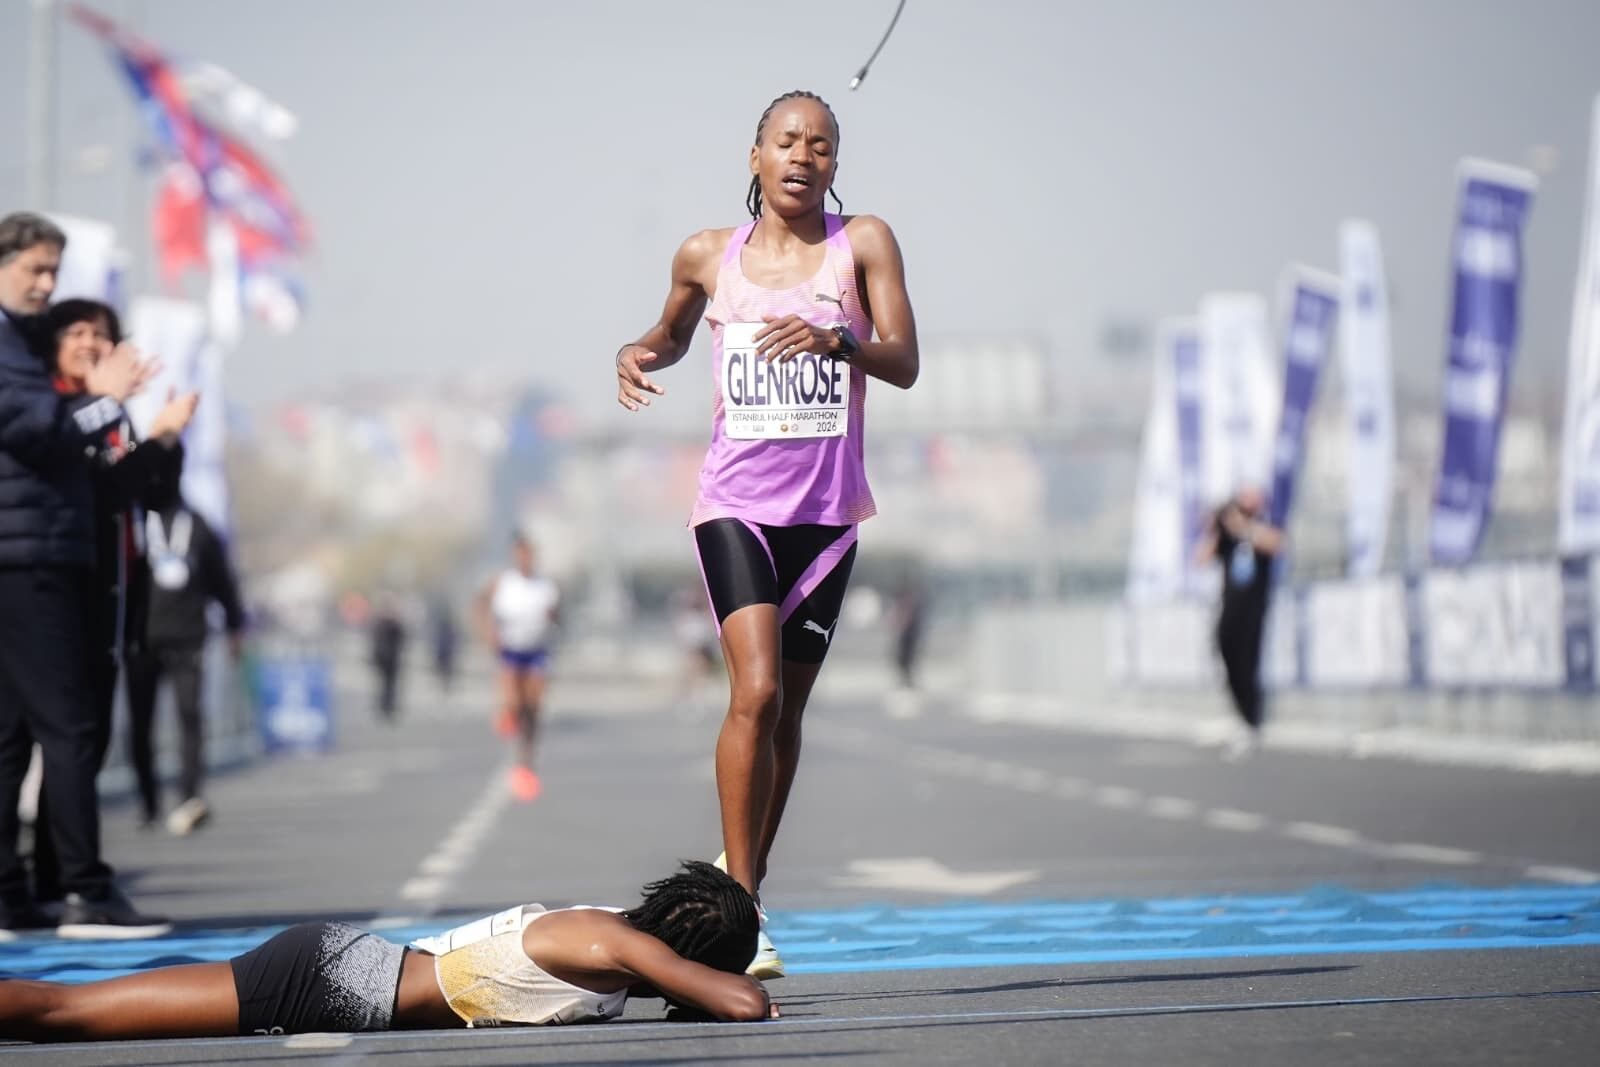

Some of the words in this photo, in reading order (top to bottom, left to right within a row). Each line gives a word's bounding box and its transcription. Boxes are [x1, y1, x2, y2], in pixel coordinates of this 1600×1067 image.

[727, 352, 842, 406] GLENROSE
[732, 411, 766, 422] ISTANBUL
[767, 411, 790, 421] HALF
[790, 411, 838, 421] MARATHON
[816, 421, 838, 433] 2026
